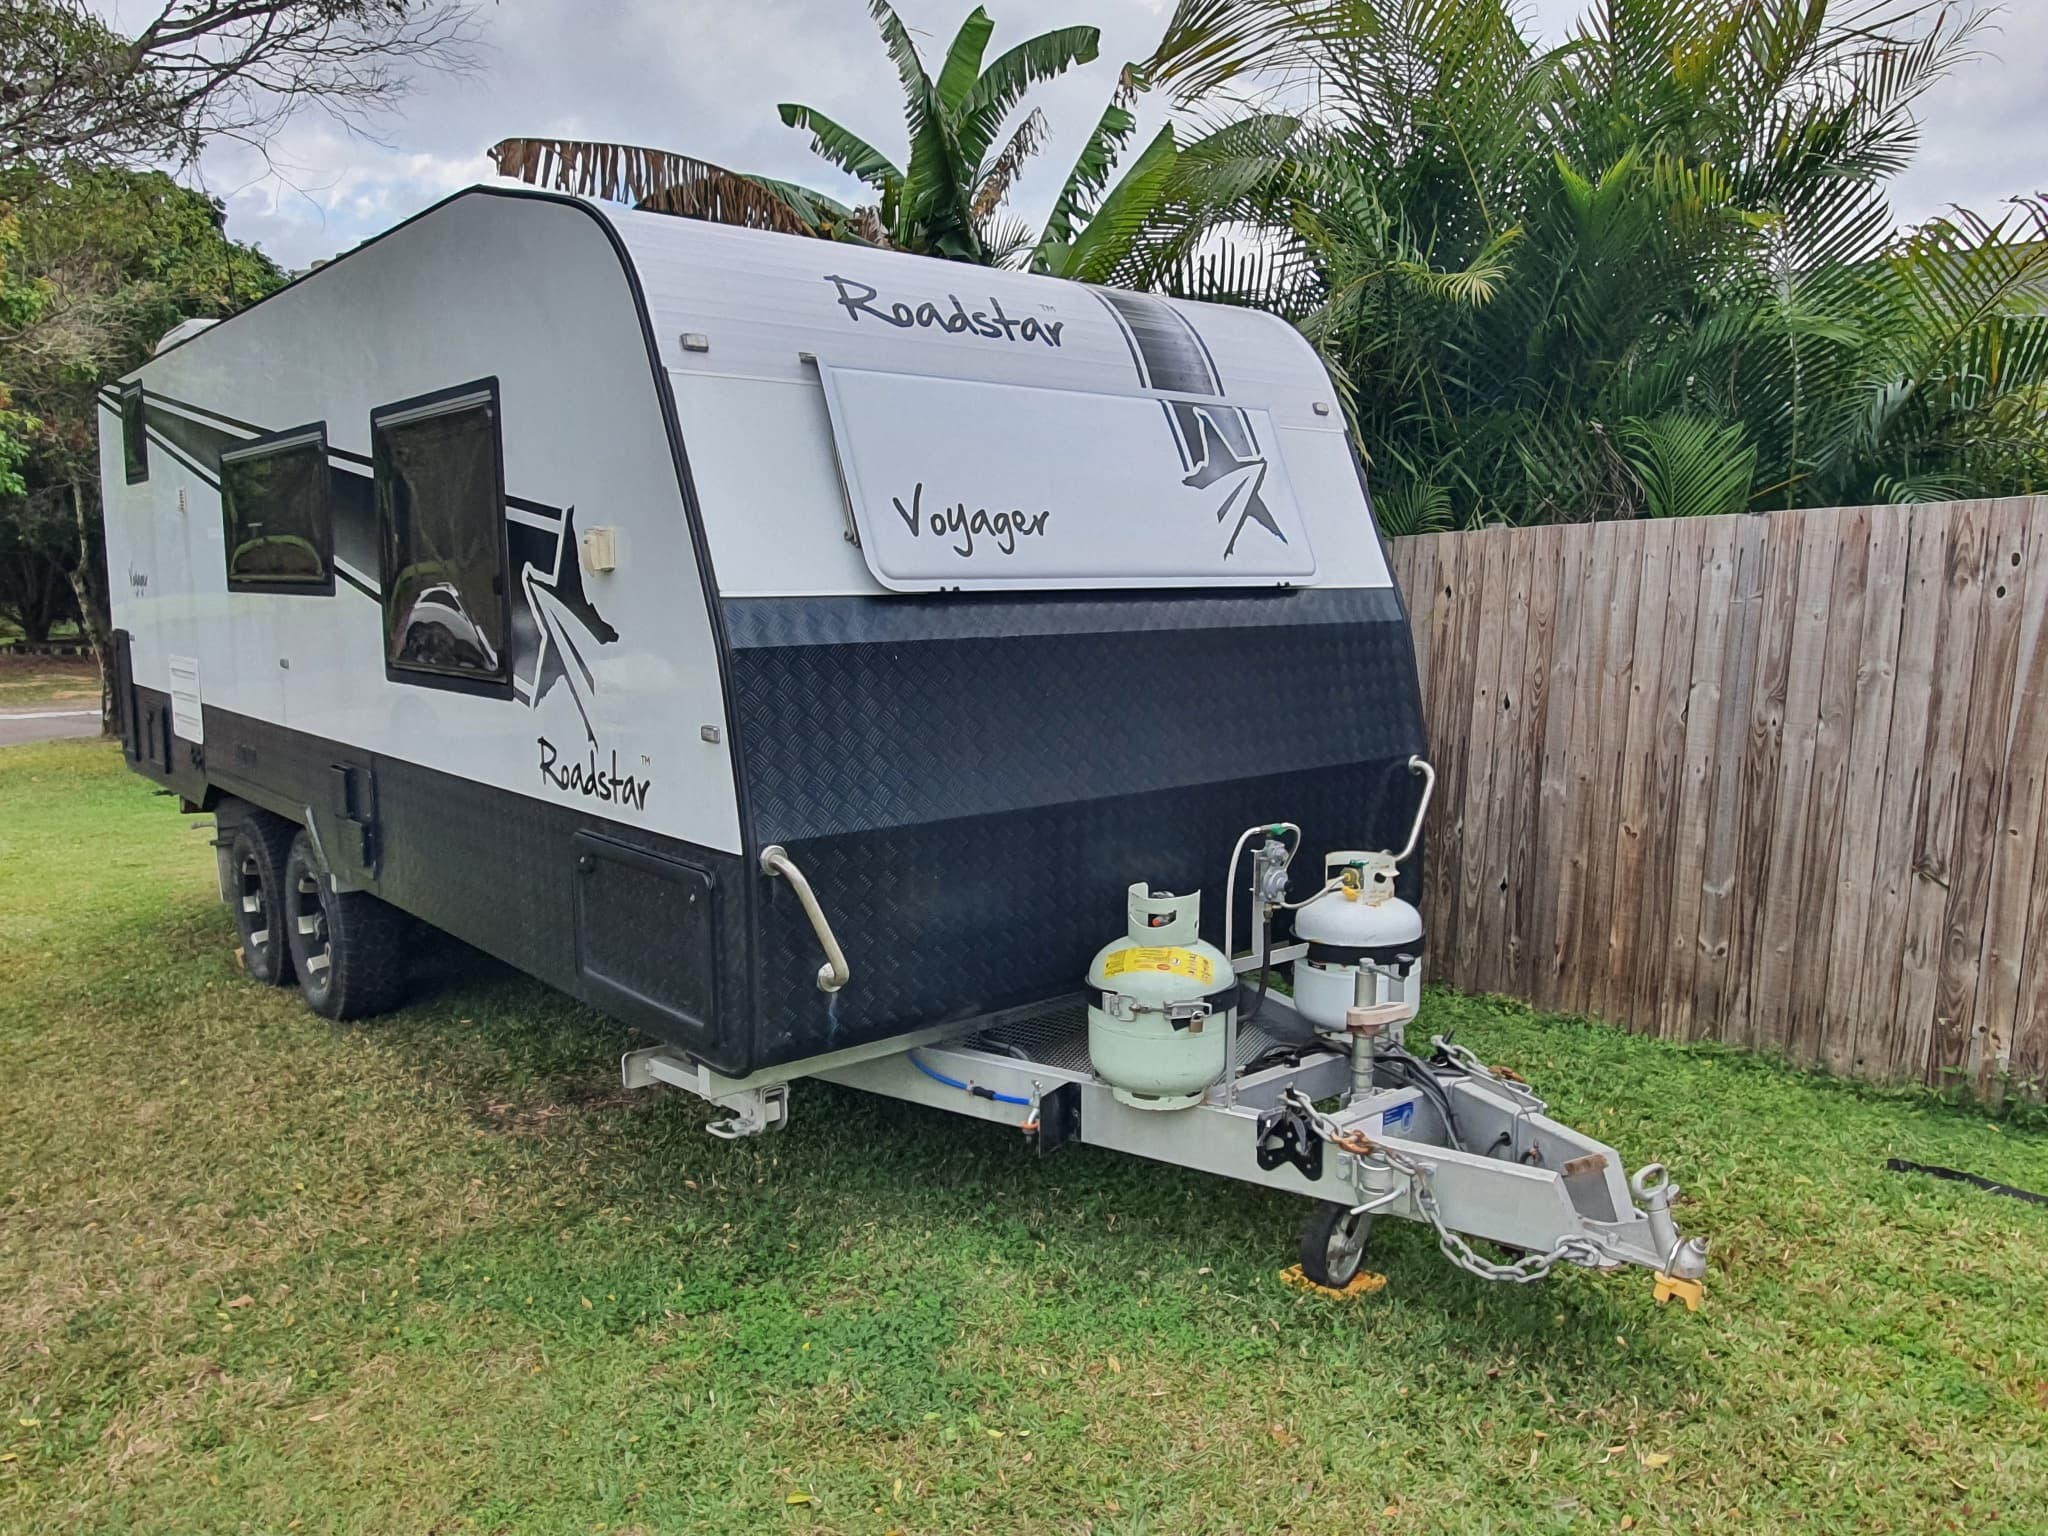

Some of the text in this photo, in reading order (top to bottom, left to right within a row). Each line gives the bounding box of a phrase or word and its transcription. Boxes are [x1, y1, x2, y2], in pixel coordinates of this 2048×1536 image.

[823, 274, 1064, 348] Roadstar
[892, 482, 1050, 558] Voyager
[537, 735, 651, 811] Roadstar
